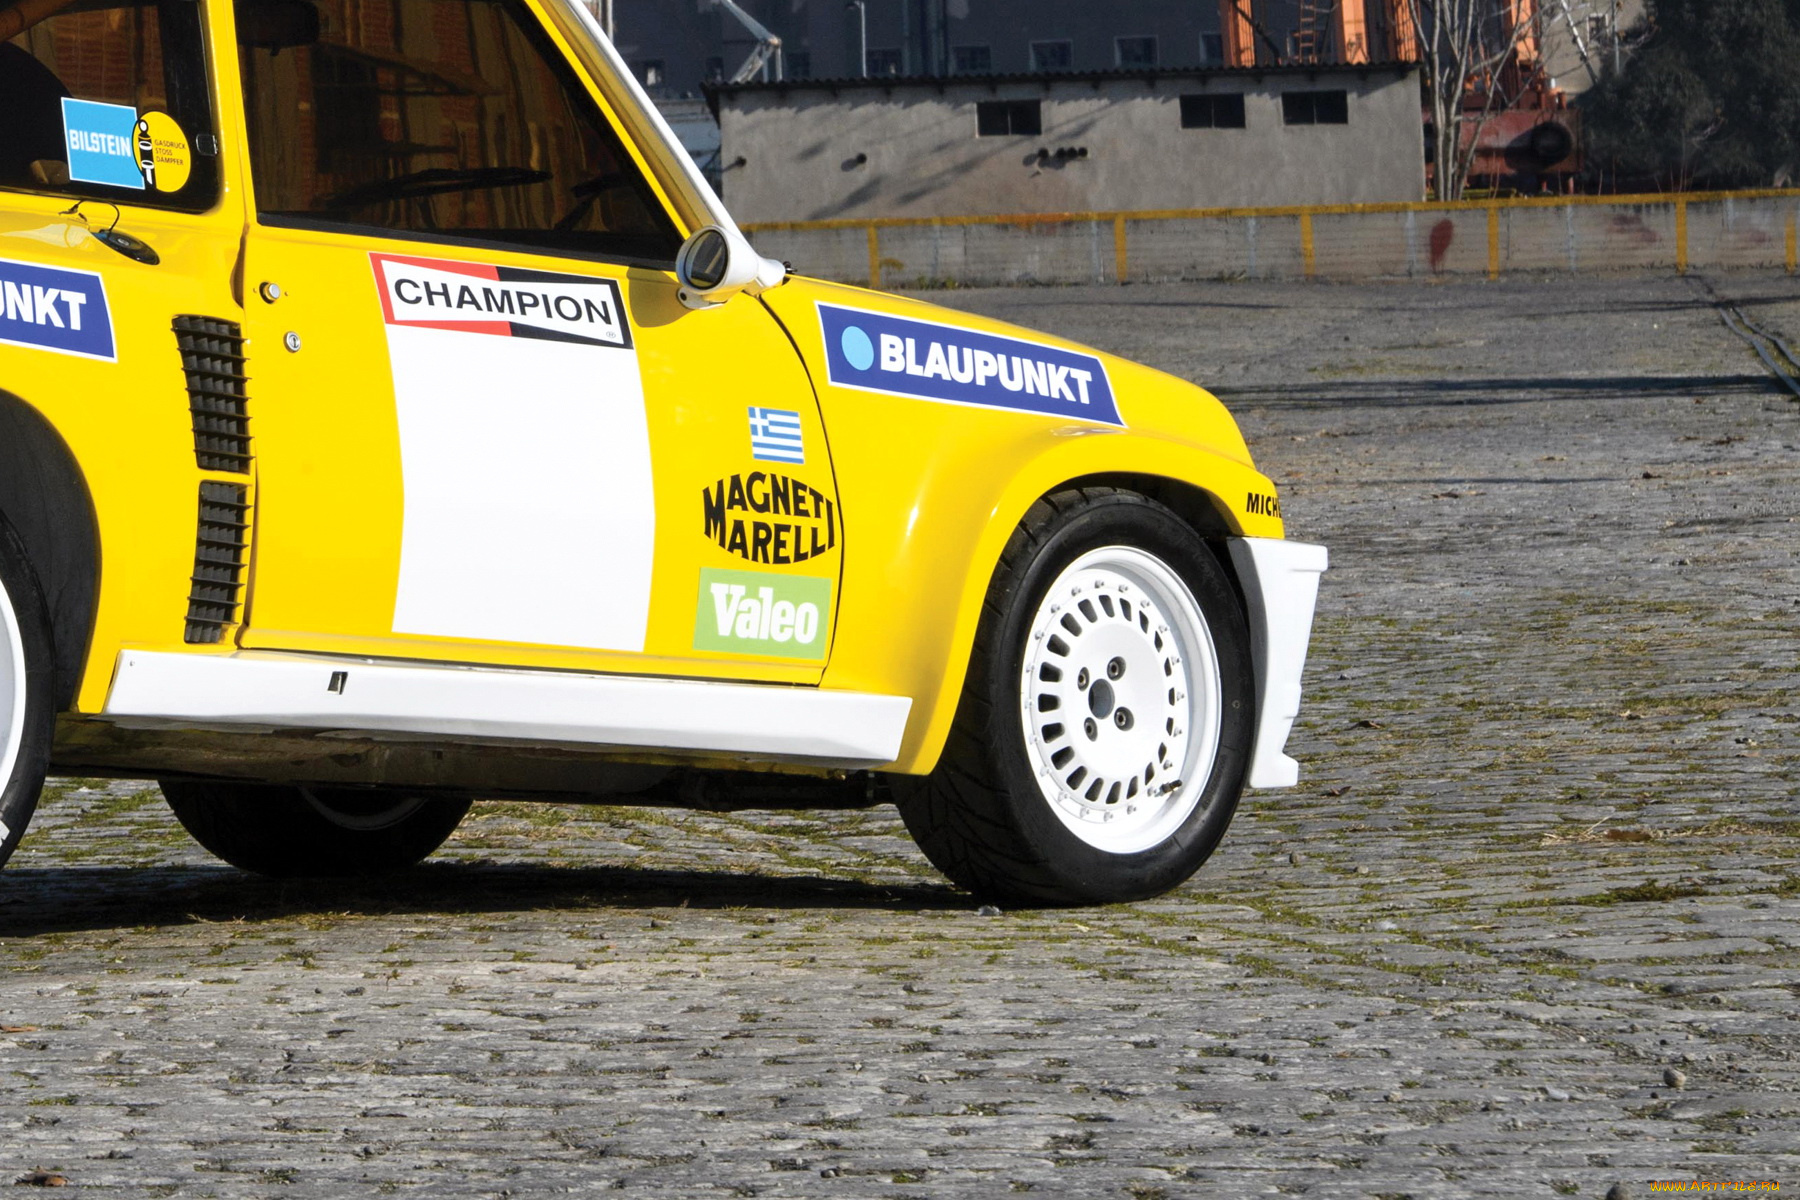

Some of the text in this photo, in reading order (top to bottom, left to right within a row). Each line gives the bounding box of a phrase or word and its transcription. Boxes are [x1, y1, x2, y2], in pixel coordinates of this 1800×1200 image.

[69, 129, 131, 157] BILSTEIN
[154, 139, 186, 149] GASDRUCK
[155, 148, 173, 156] STOSS
[394, 278, 612, 326] CHAMPION
[880, 333, 1092, 405] BLAUPUNKT
[702, 471, 835, 526] MAGNETI
[703, 517, 836, 565] MARELLI
[710, 582, 819, 644] Valeo
